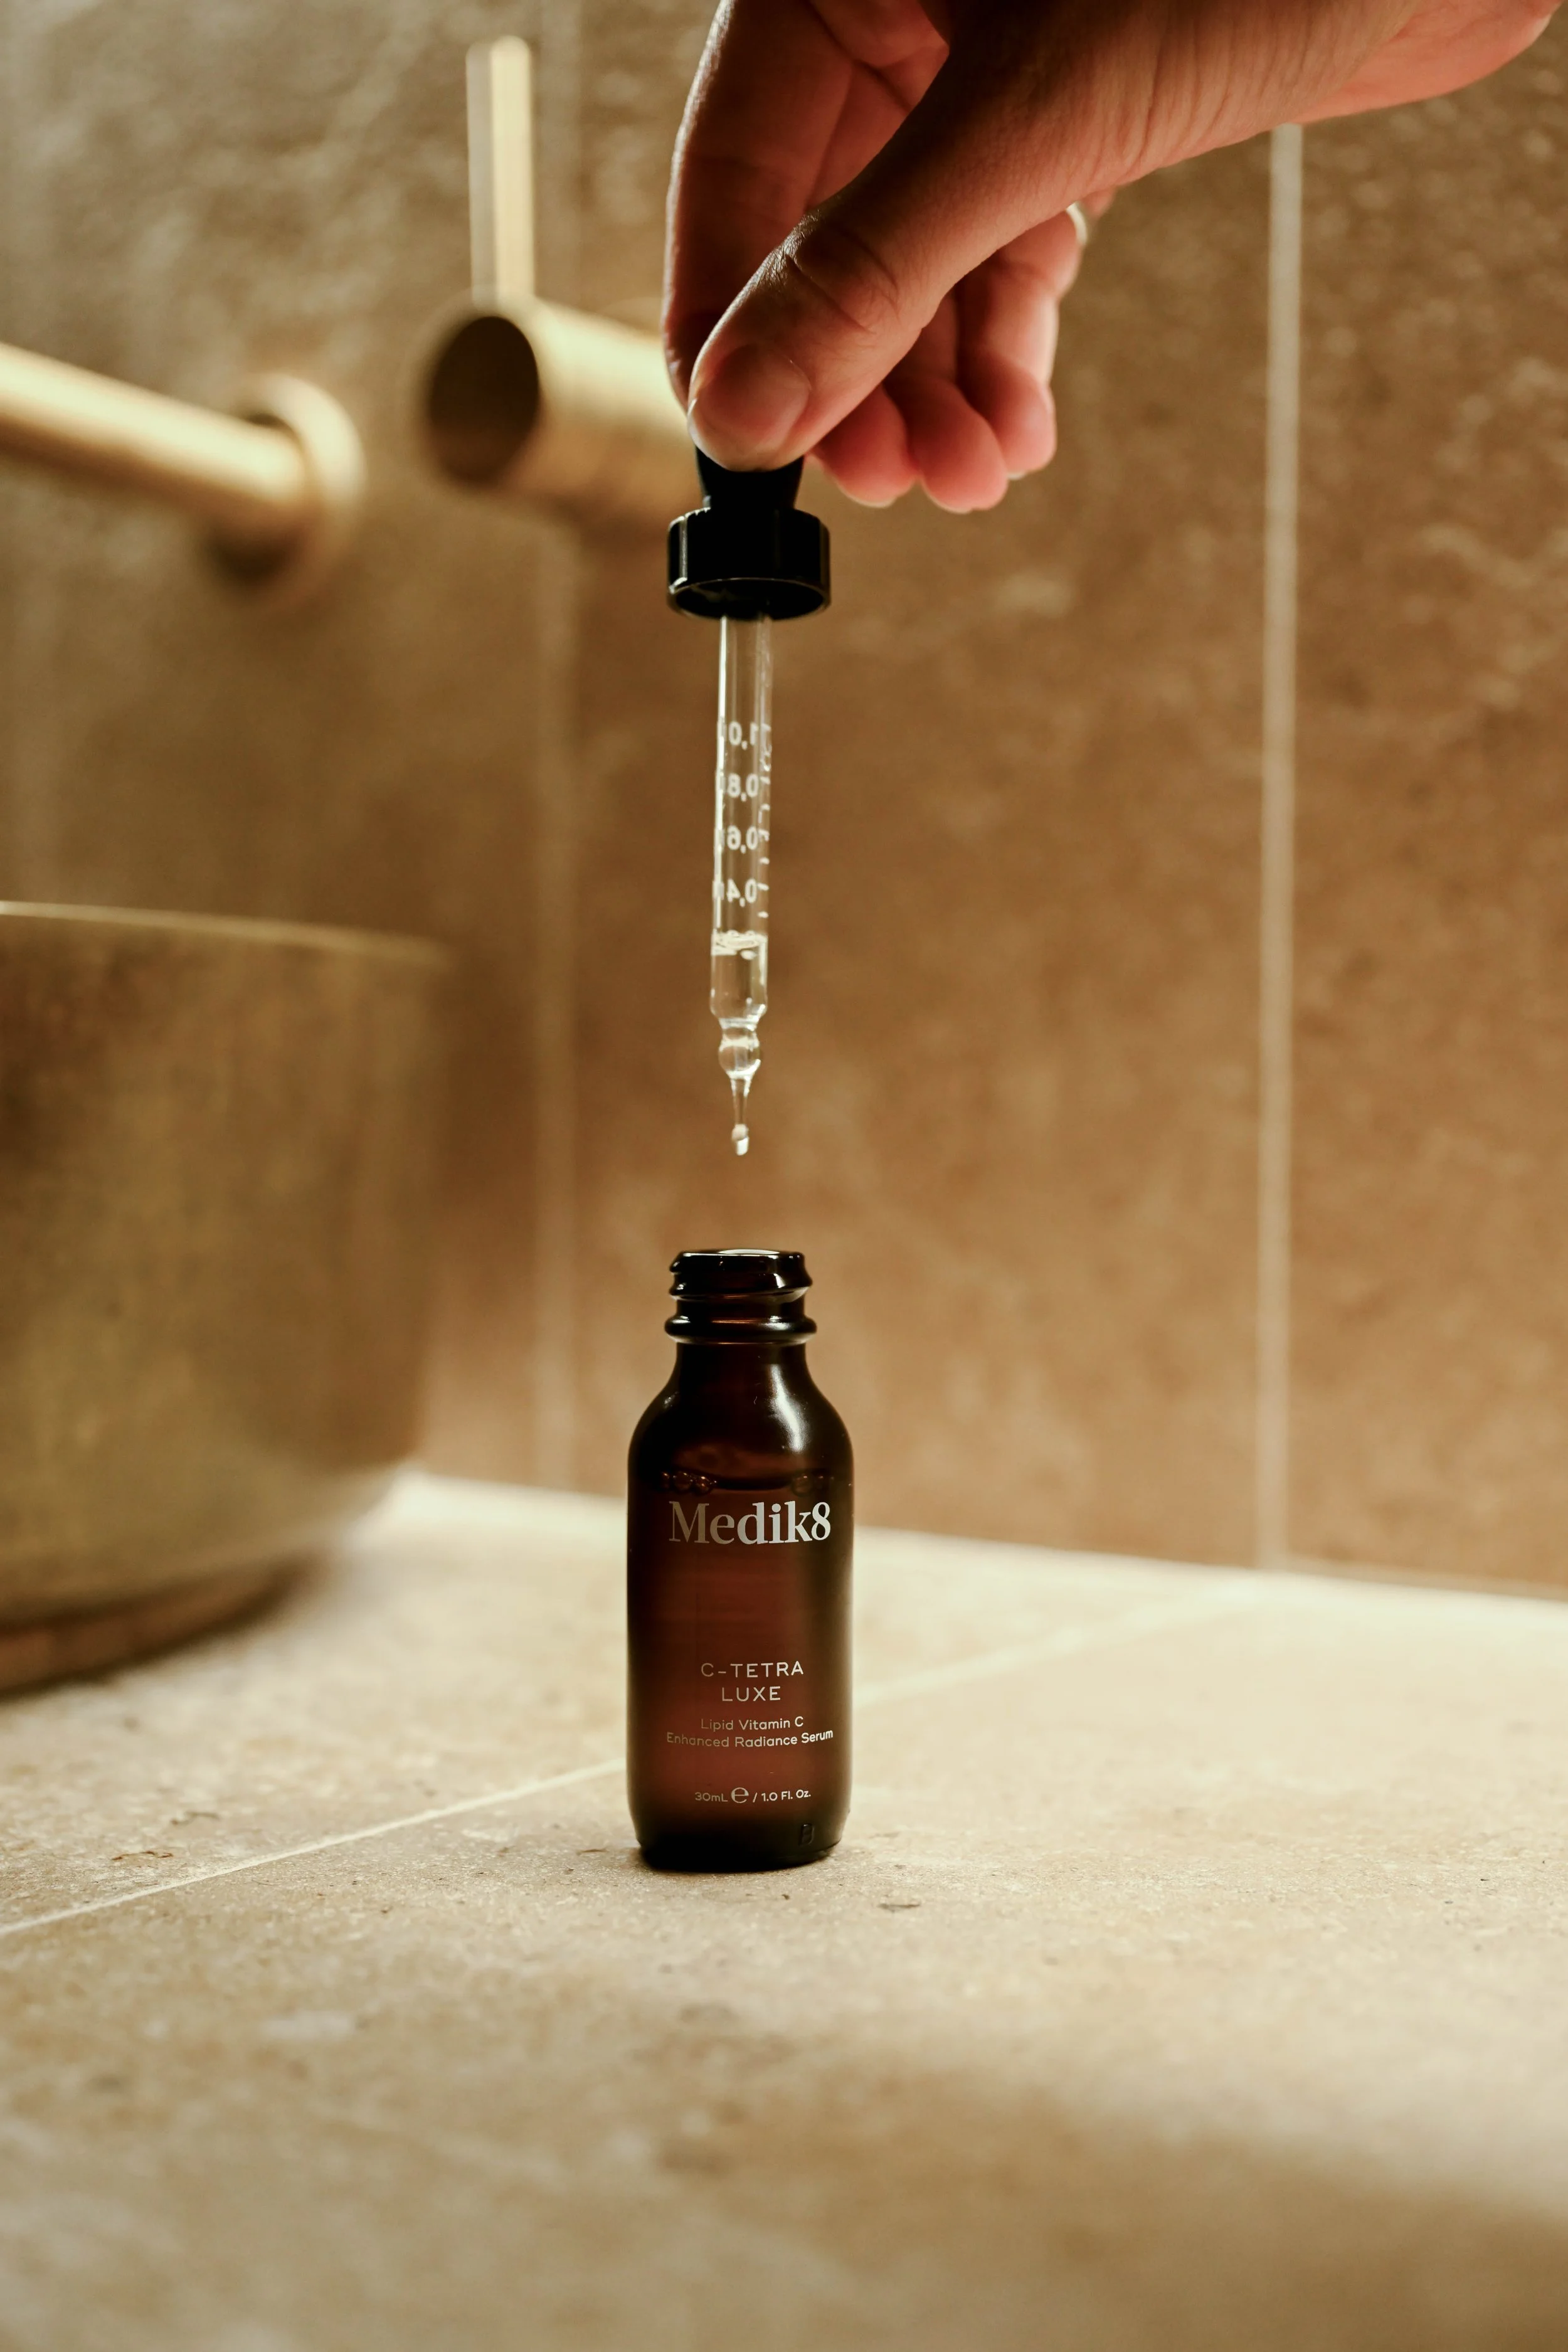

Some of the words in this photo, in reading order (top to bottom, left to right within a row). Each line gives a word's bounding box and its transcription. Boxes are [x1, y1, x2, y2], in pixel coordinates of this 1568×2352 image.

[669, 1500, 831, 1545] Medik8
[701, 1661, 804, 1678] C-TETRA
[721, 1686, 781, 1702] LUXE
[701, 1718, 734, 1732] Lipid
[738, 1718, 790, 1730] Vitamin
[795, 1716, 804, 1727] C
[667, 1732, 729, 1747] Enhanced
[735, 1735, 798, 1747] Radiance
[801, 1729, 834, 1744] Serum
[695, 1792, 728, 1803] 30mL
[761, 1792, 778, 1802] 1.0
[796, 1789, 812, 1799] Oz.
